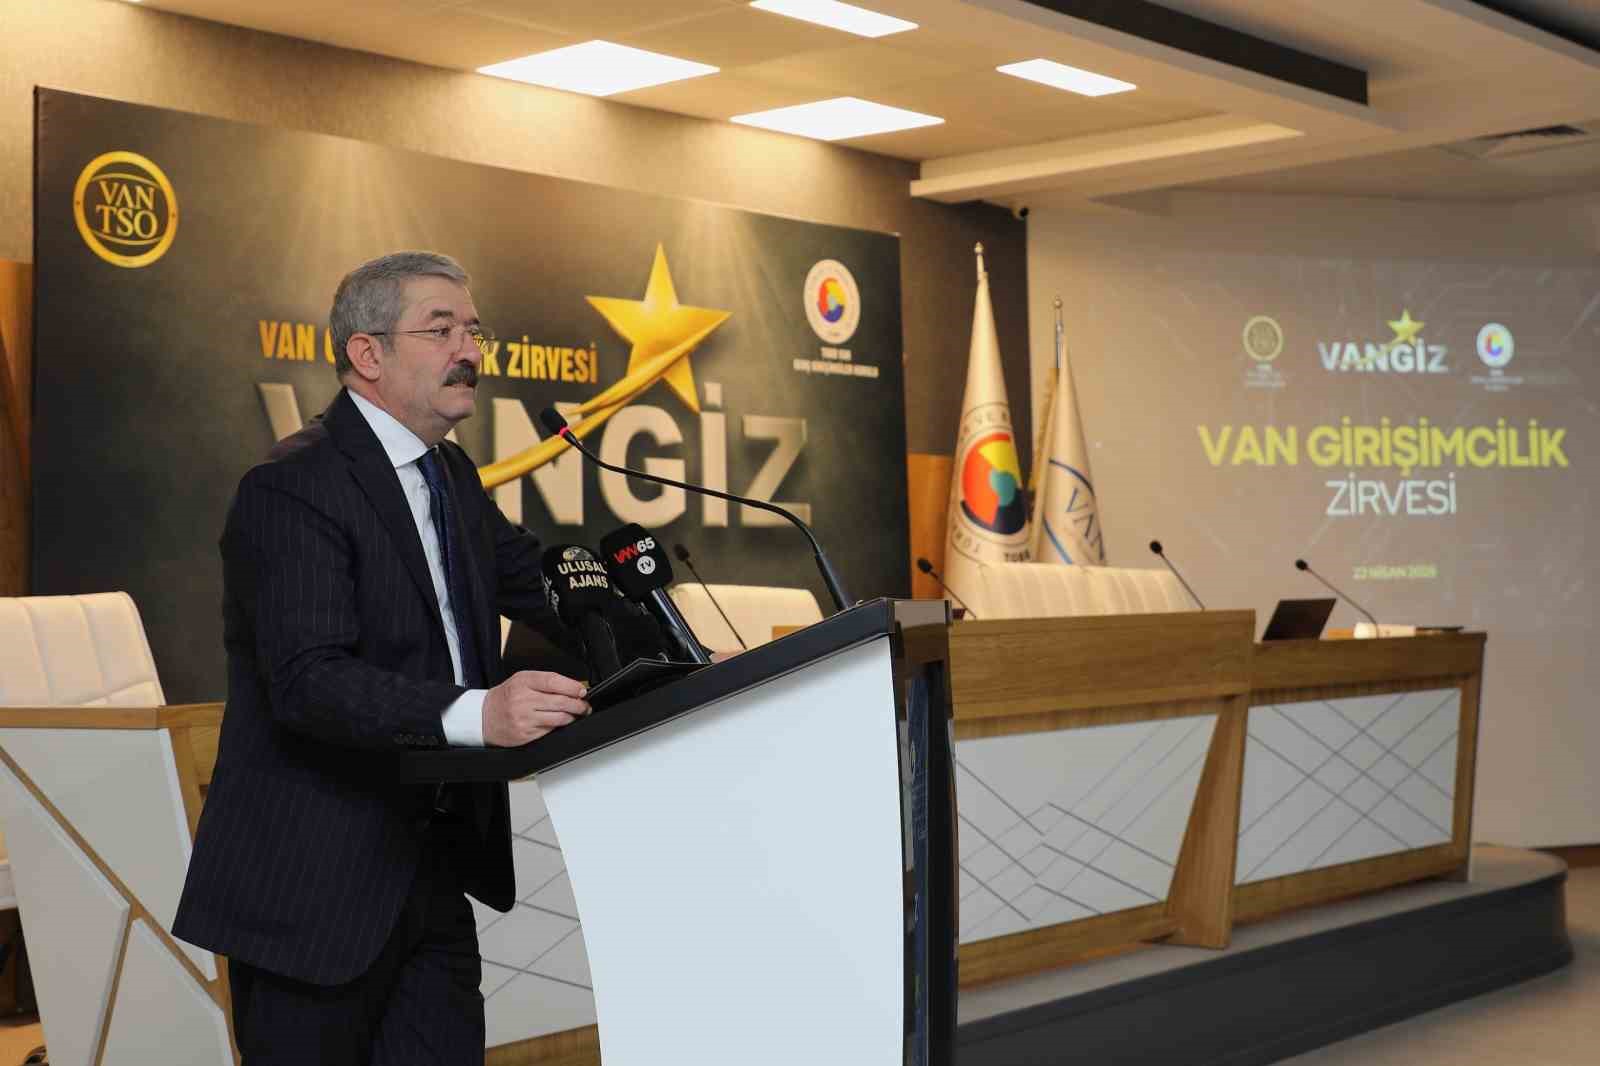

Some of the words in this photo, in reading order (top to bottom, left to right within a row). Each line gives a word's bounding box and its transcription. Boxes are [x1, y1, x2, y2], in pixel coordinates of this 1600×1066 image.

[99, 180, 155, 209] VAN
[96, 204, 158, 239] TSO
[259, 319, 316, 361] VAN
[506, 334, 598, 383] ZİRVESİ
[1317, 337, 1449, 373] VANGİZ
[1197, 423, 1298, 467] VAN
[1305, 415, 1569, 478] GİRİŞİMCİLİK
[1325, 471, 1456, 516] ZİRVESİ
[558, 561, 607, 574] ULUSAL
[569, 575, 608, 589] AJANS
